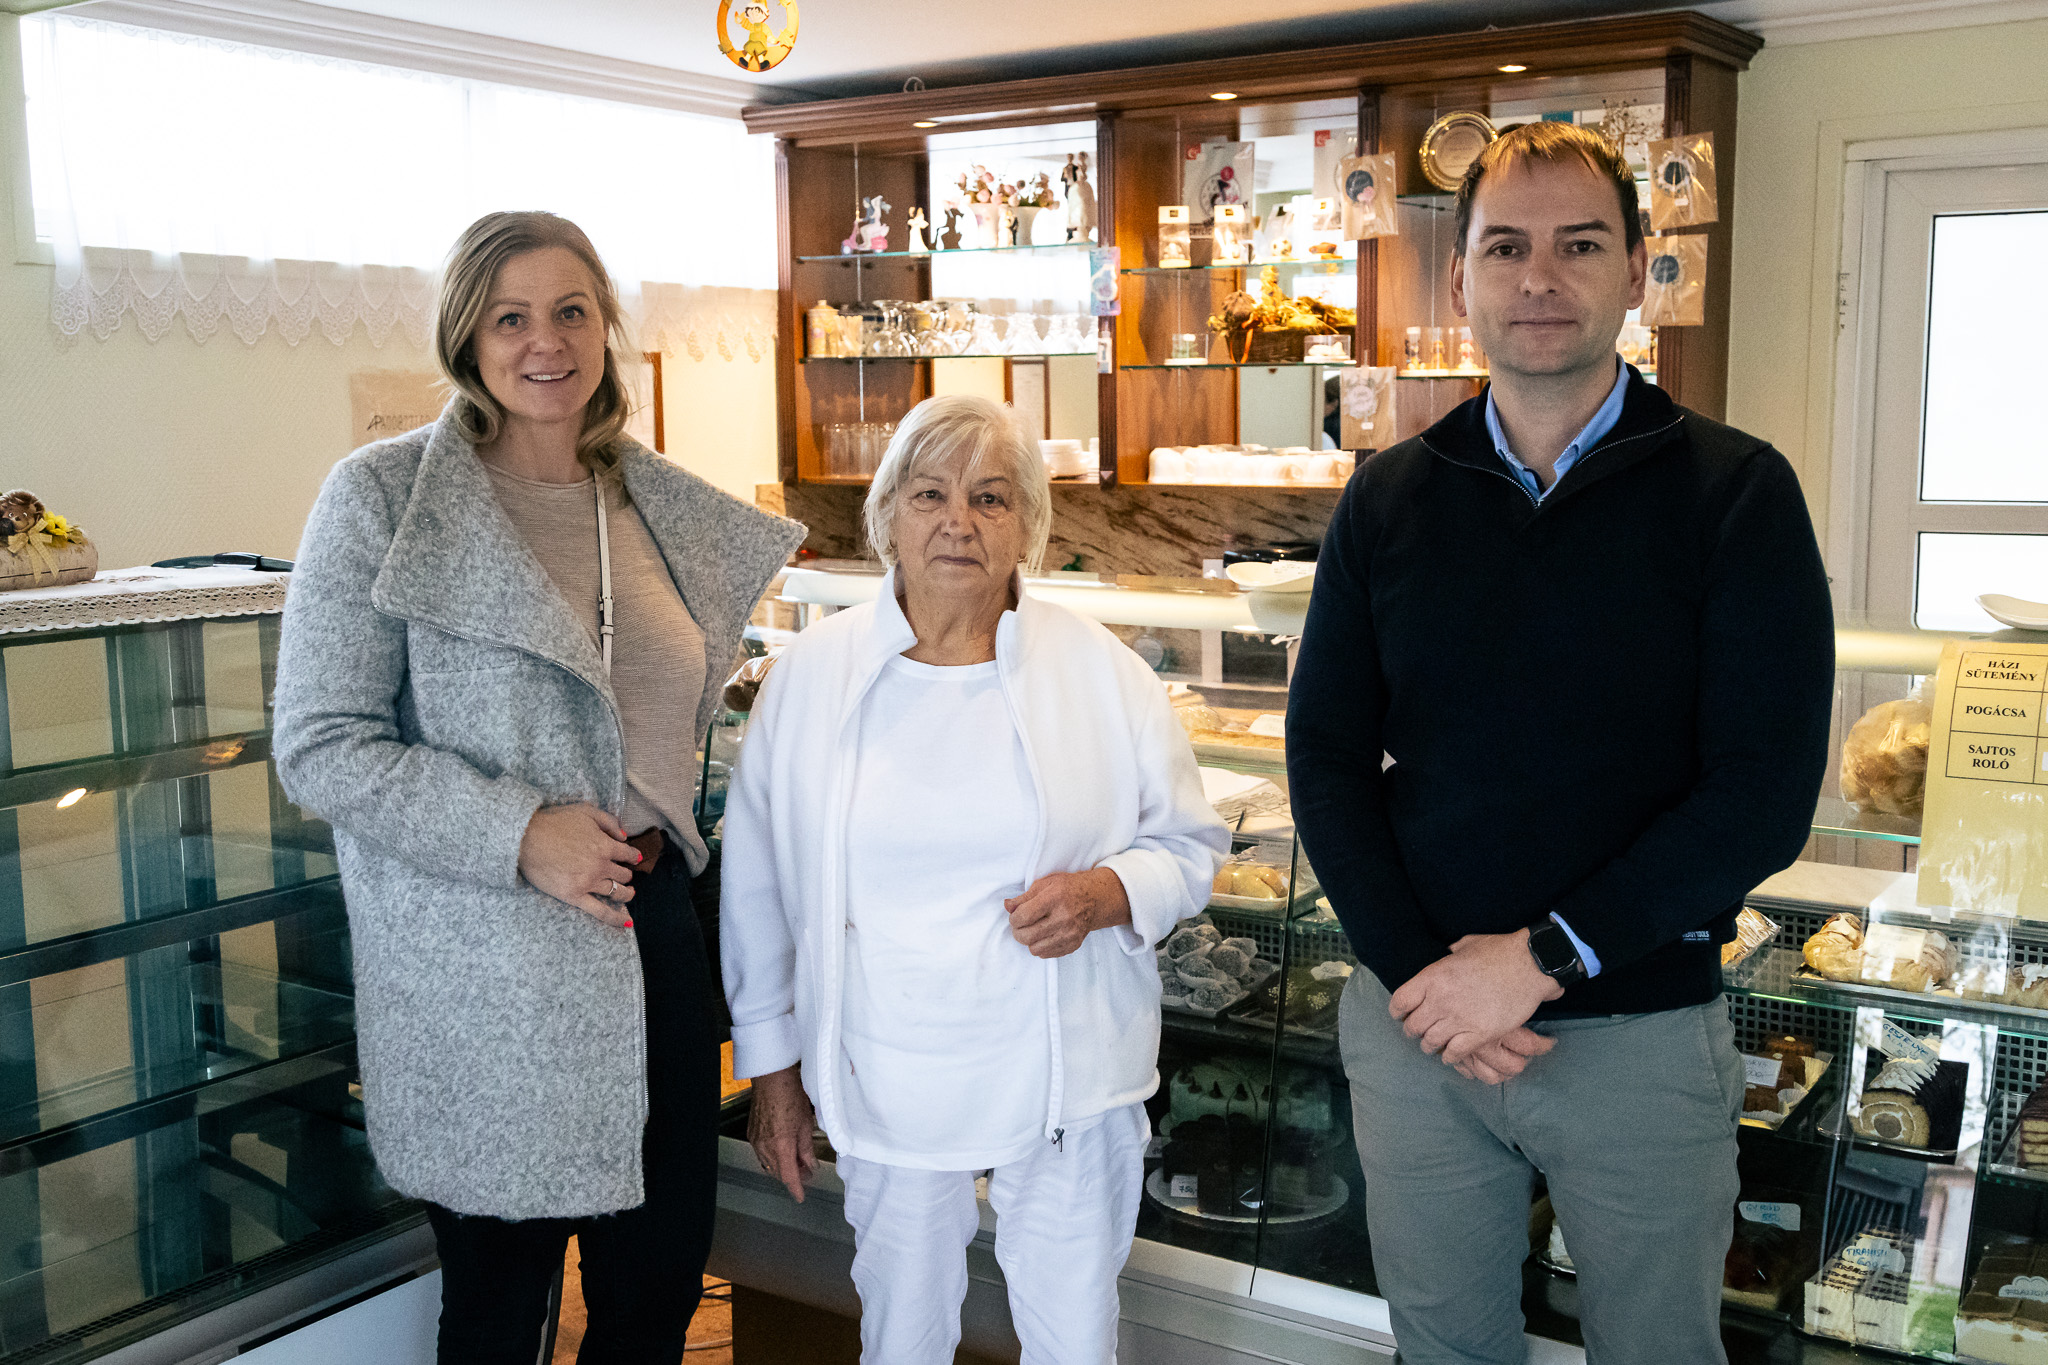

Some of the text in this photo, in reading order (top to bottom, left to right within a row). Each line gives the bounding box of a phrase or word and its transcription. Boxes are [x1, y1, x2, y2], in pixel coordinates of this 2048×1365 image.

[1987, 658, 2020, 670] HÁZI
[1965, 668, 2038, 682] SÜTEMÉNY
[1965, 704, 2027, 718] POGÁCSA
[1967, 744, 2016, 757] SAJTOS
[1972, 757, 2010, 770] ROLÓ
